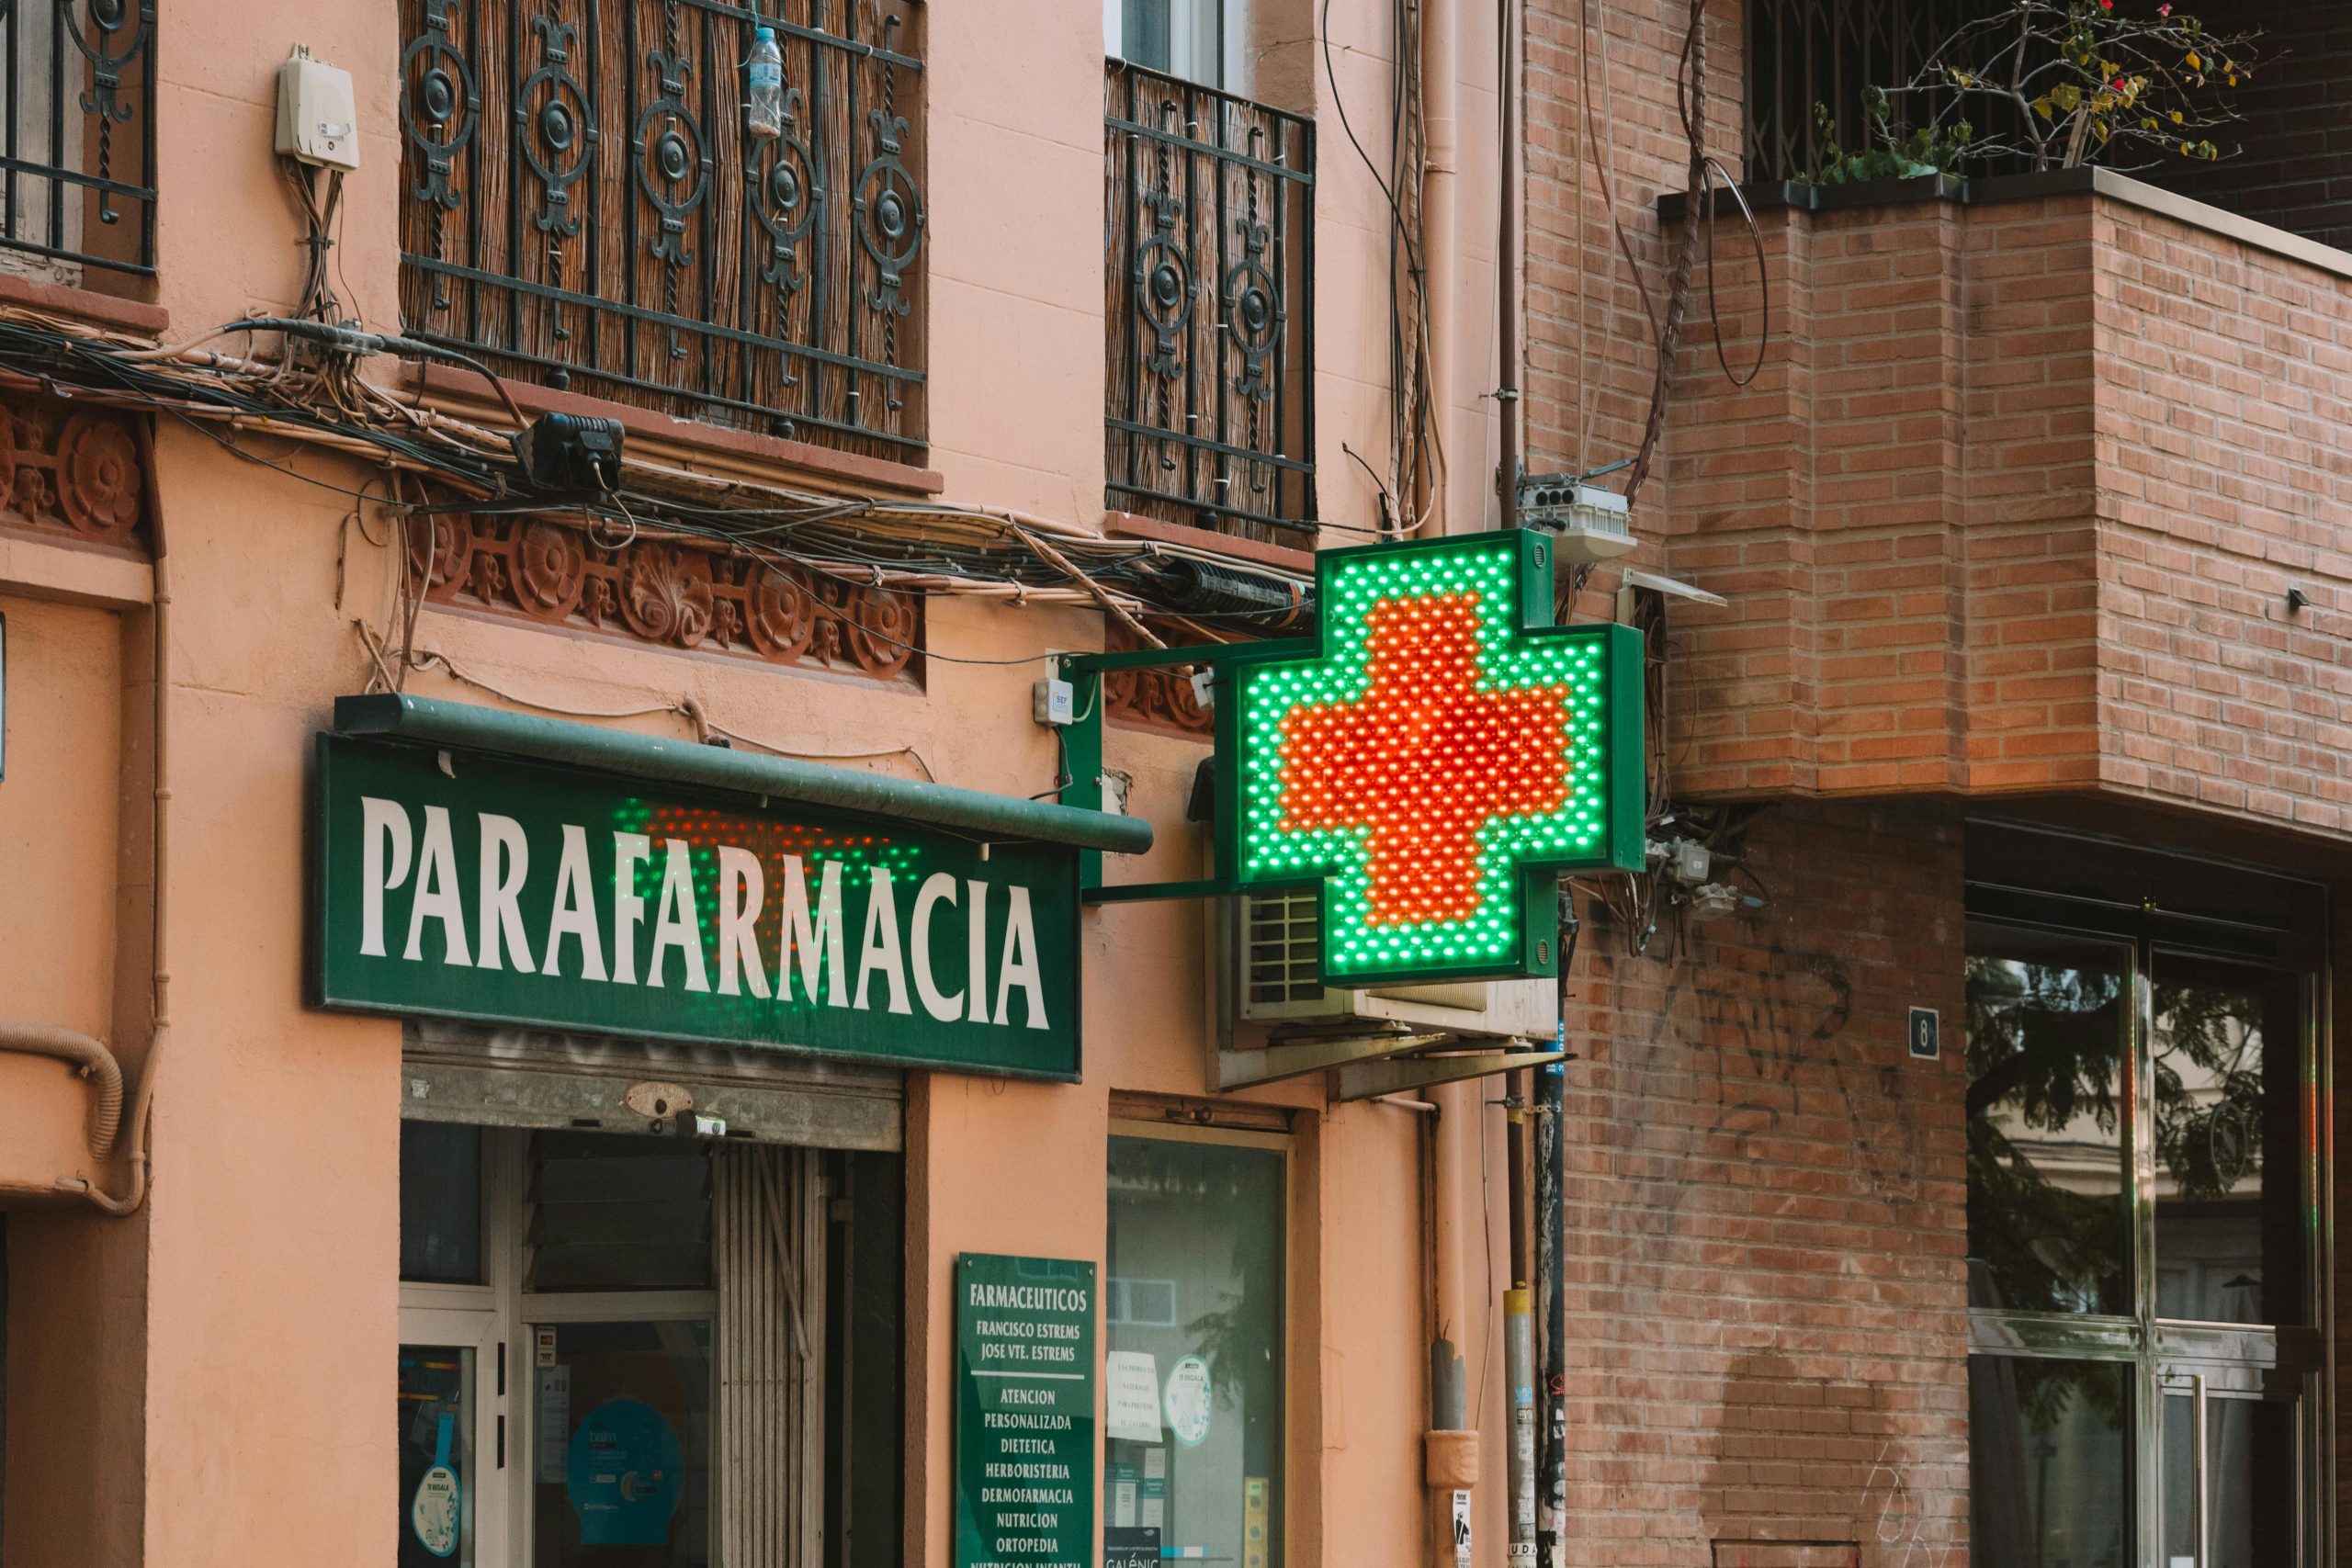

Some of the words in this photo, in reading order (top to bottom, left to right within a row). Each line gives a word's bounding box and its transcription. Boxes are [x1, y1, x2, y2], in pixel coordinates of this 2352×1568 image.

[358, 795, 1051, 1031] PARAFARMACIA
[1920, 1019, 1928, 1048] 8
[970, 1283, 1087, 1313] FARMACEUTICOS
[977, 1320, 1035, 1337] FRANCISCO
[1036, 1324, 1080, 1340] ESTREMS
[981, 1343, 1005, 1361] JOSE
[1008, 1344, 1029, 1359] VTE.
[1032, 1346, 1075, 1361] ESTREMS
[1001, 1388, 1056, 1405] ATENCION
[984, 1413, 1072, 1430] PERSONALIZADA
[1001, 1438, 1056, 1455] DIETETICA
[986, 1462, 1070, 1479] HERBORISTERIA
[981, 1487, 1074, 1504] DERMOFARMACIA
[997, 1513, 1058, 1529] NUTRICION
[996, 1538, 1058, 1553] ORTOPEDIA
